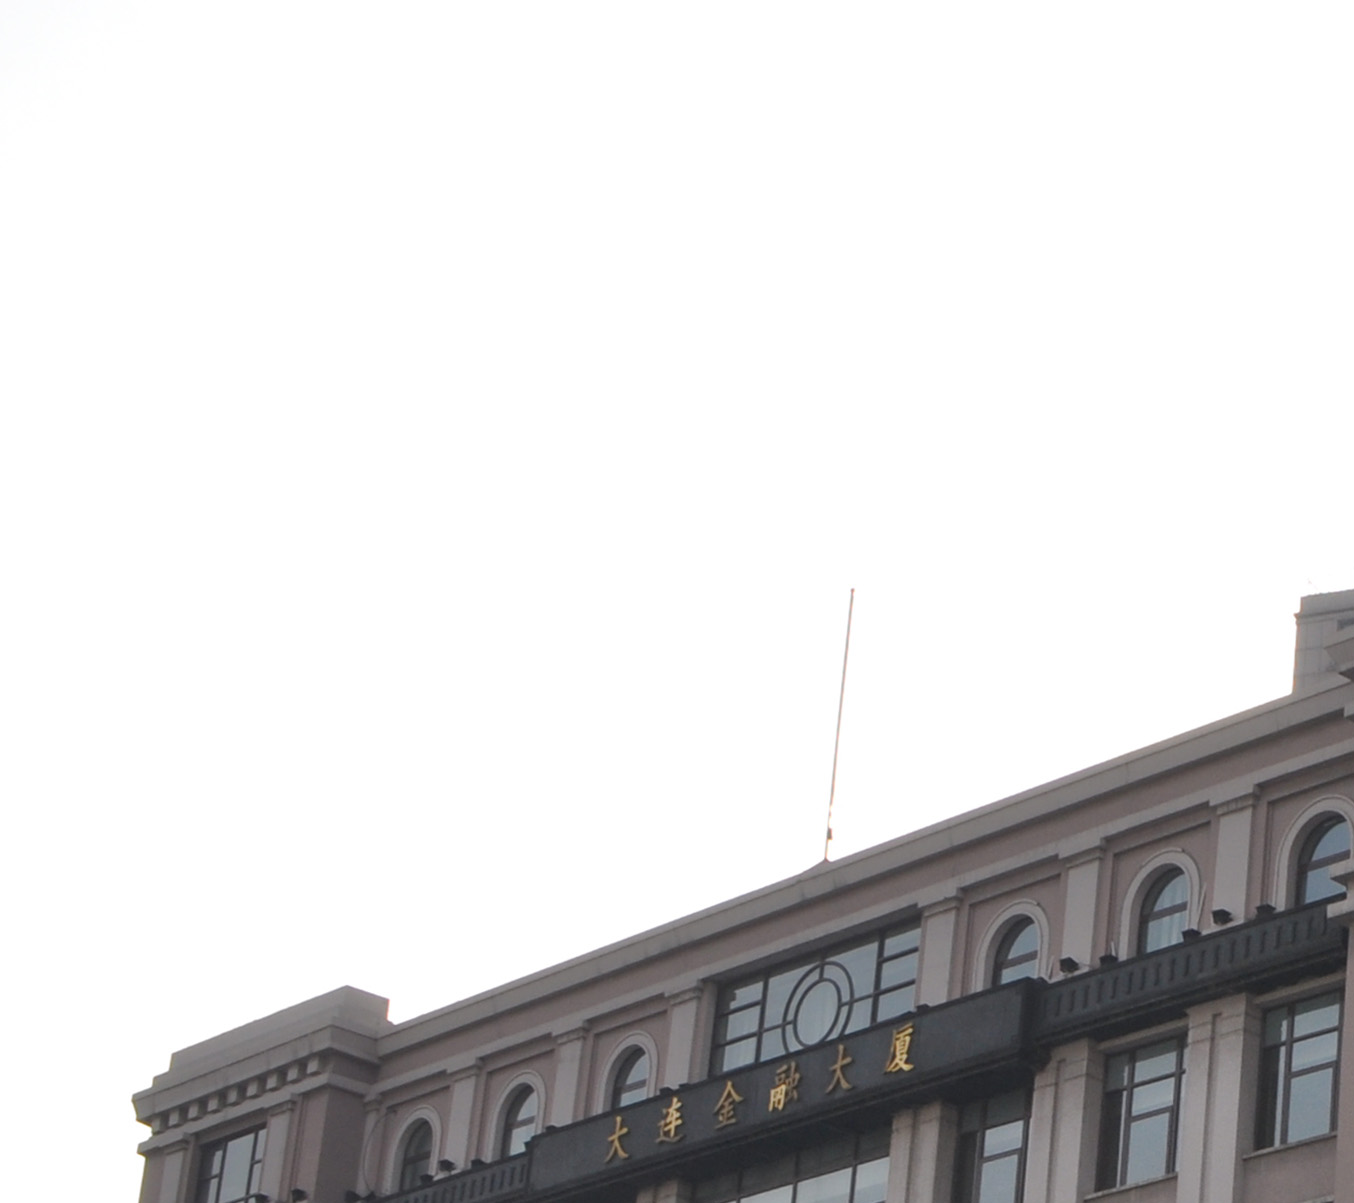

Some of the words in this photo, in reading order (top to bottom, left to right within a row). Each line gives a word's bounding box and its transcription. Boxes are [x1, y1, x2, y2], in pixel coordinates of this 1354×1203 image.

[604, 1022, 916, 1163] 大连金融大厦
